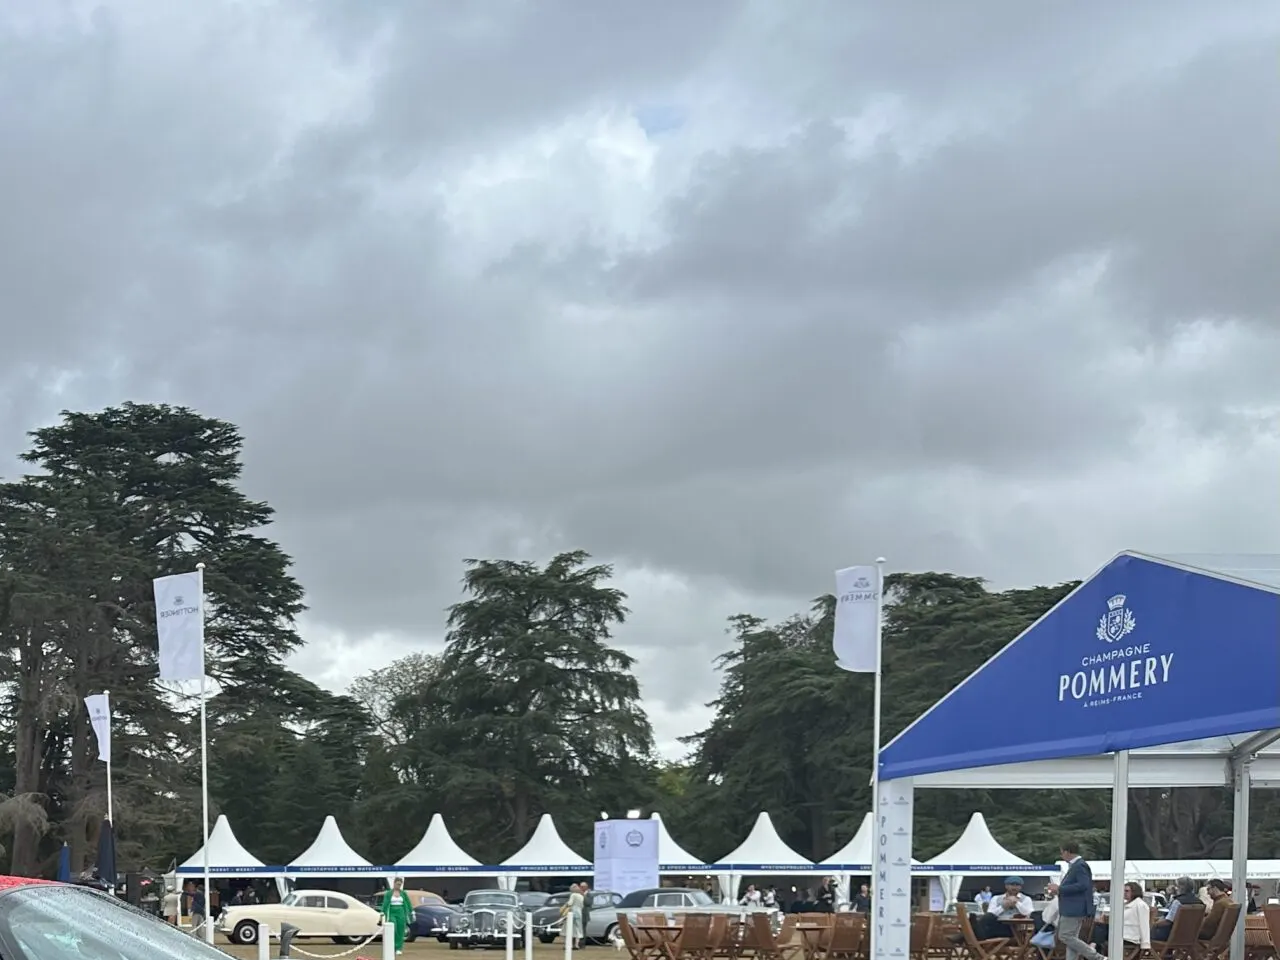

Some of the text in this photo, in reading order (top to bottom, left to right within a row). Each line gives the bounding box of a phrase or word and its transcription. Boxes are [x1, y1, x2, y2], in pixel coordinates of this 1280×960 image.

[1058, 652, 1175, 702] POMMERY
[1082, 644, 1150, 666] CHAMPAGNE
[878, 815, 887, 937] POMMERY
